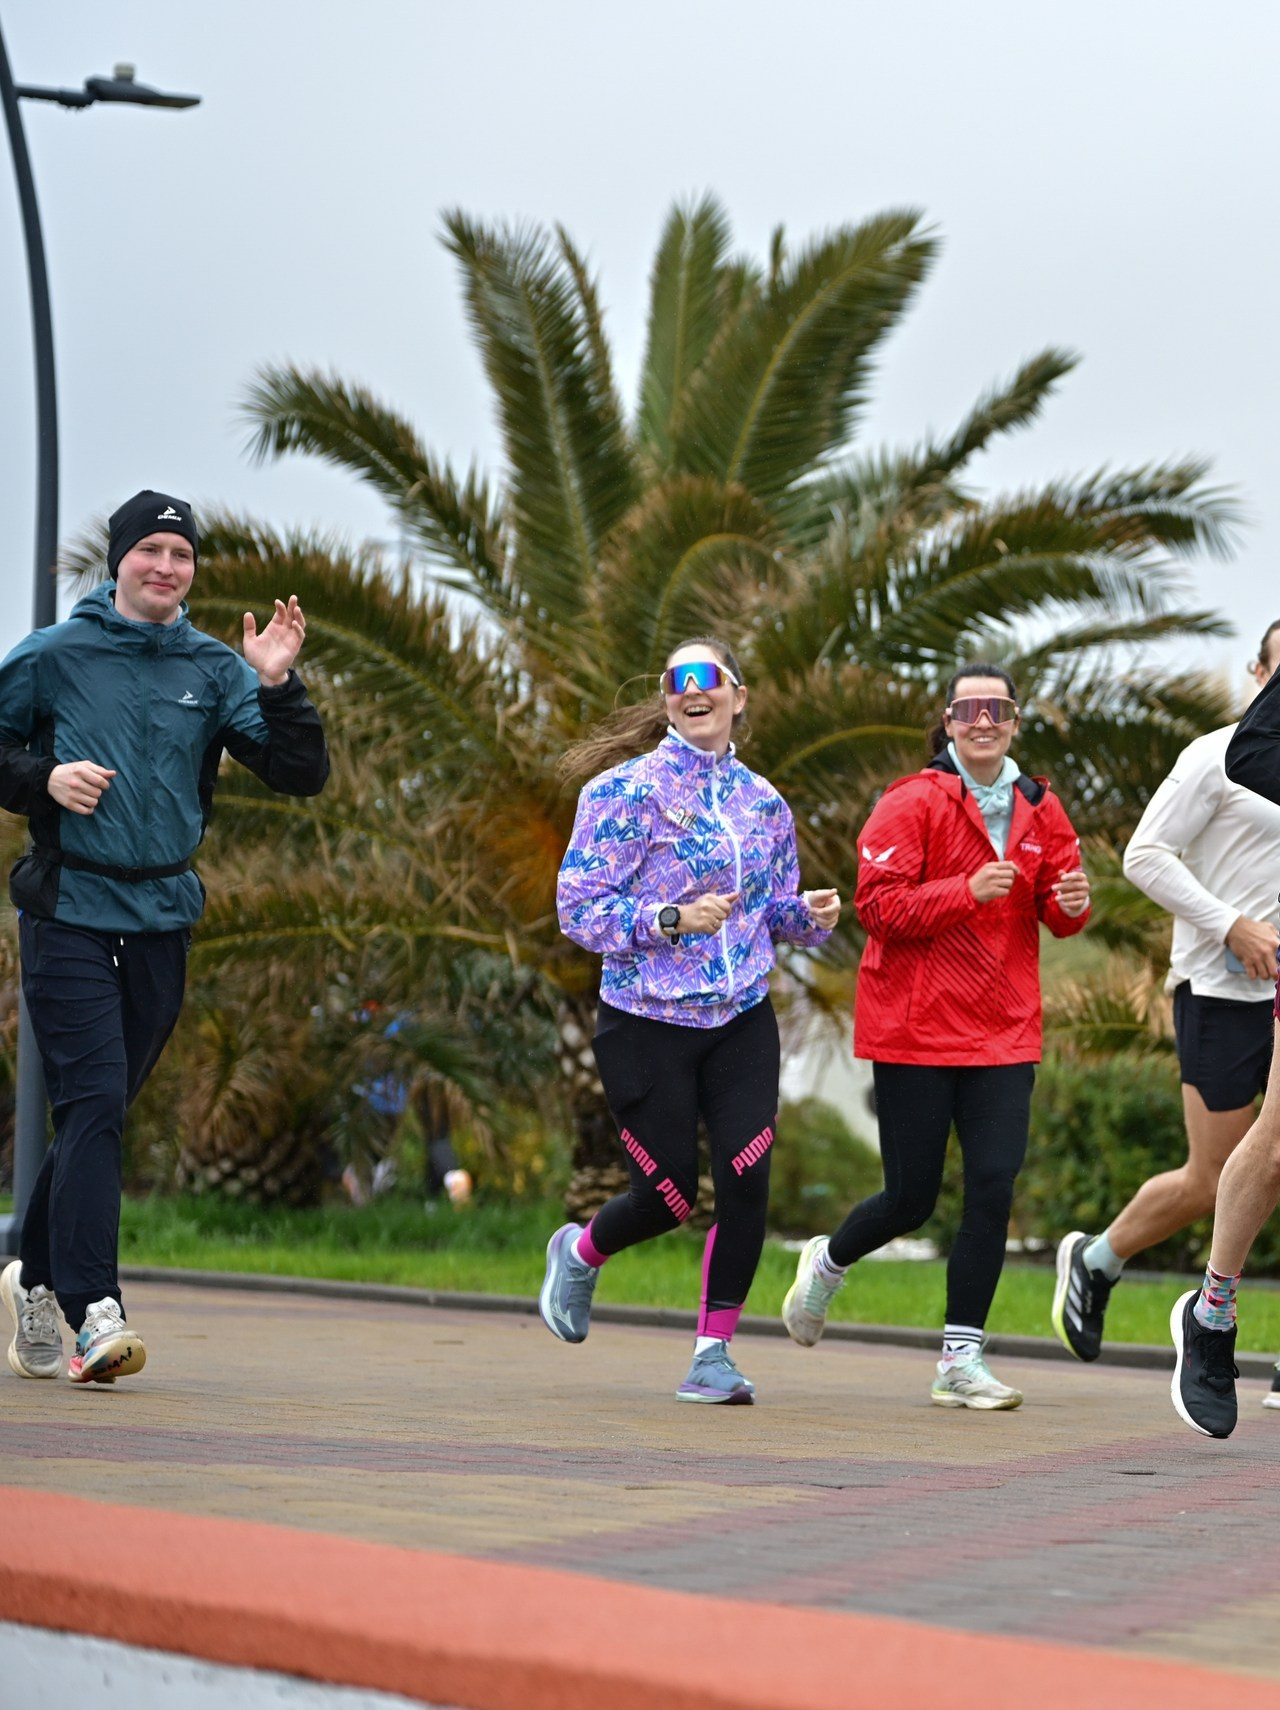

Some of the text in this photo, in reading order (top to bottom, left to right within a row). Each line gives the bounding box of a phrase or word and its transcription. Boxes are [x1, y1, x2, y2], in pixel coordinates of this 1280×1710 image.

[620, 1127, 658, 1177] PUMA
[730, 1126, 774, 1177] PUMA
[655, 1177, 693, 1224] PUM
